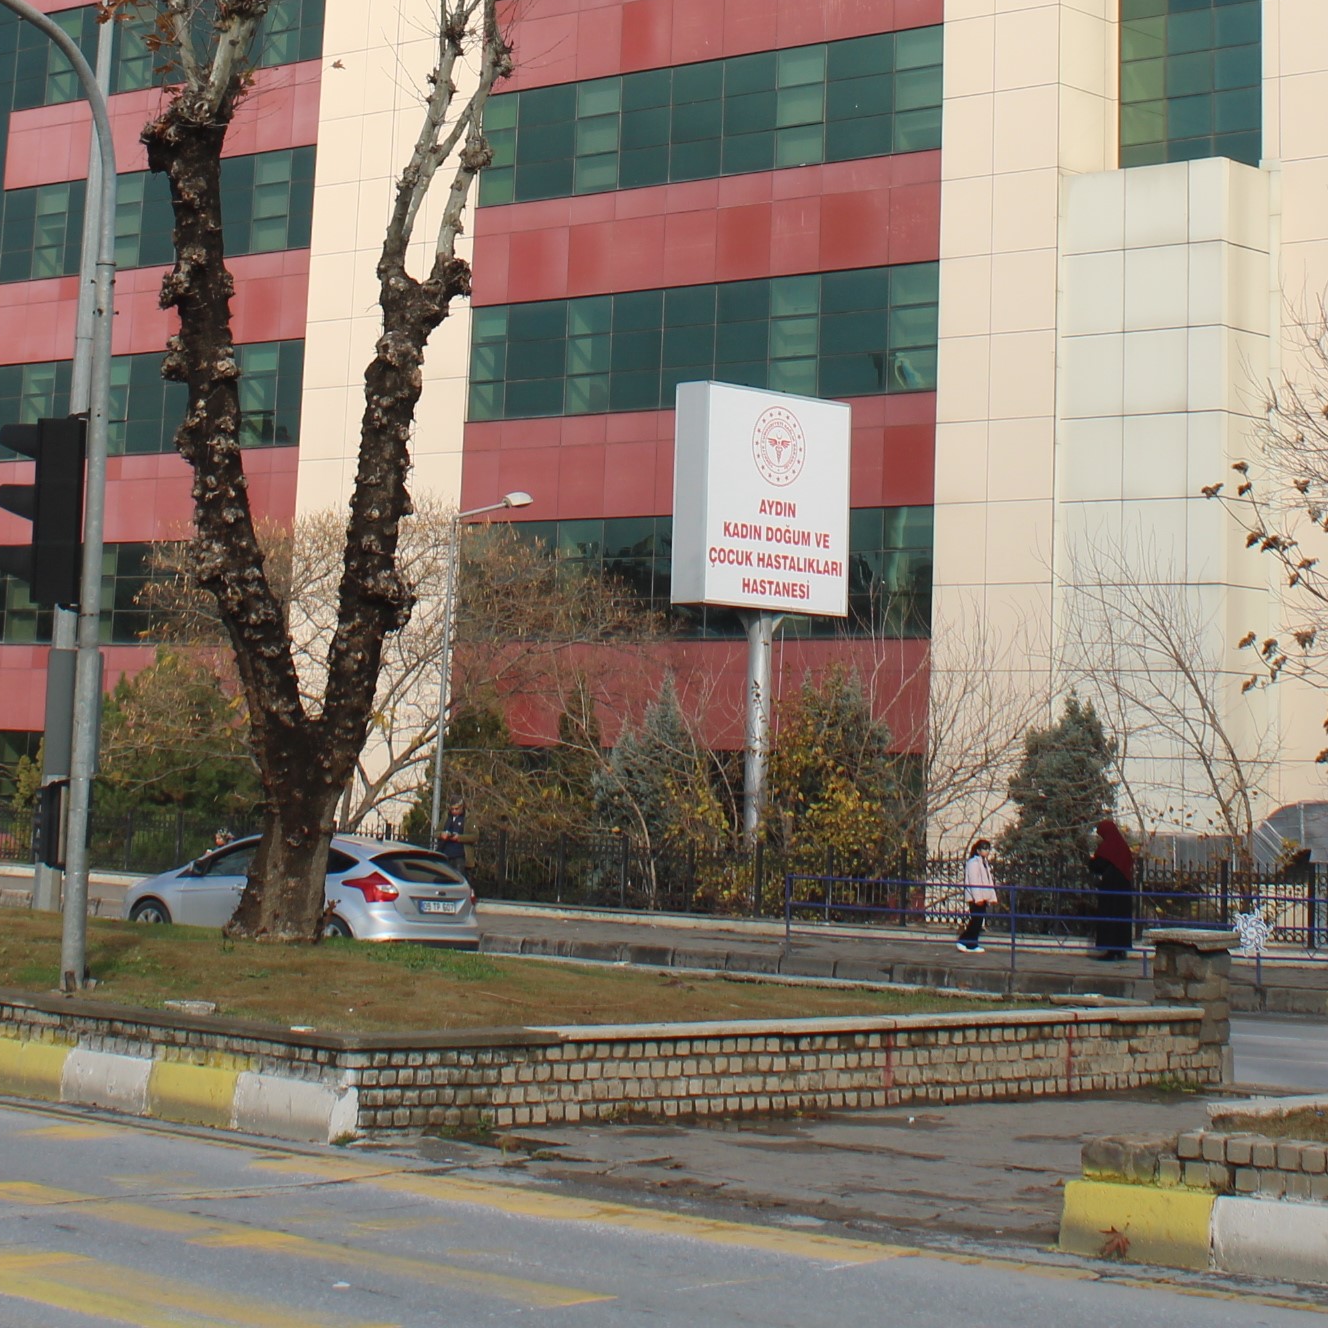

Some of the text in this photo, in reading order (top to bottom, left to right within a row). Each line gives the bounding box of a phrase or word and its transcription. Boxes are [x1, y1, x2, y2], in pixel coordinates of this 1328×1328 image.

[758, 498, 797, 518] AYDIN
[723, 521, 830, 549] KADIN DOĞUM VE
[708, 546, 843, 577] ÇOCUK HASTALIKLARI
[741, 577, 810, 600] HASTANESİ
